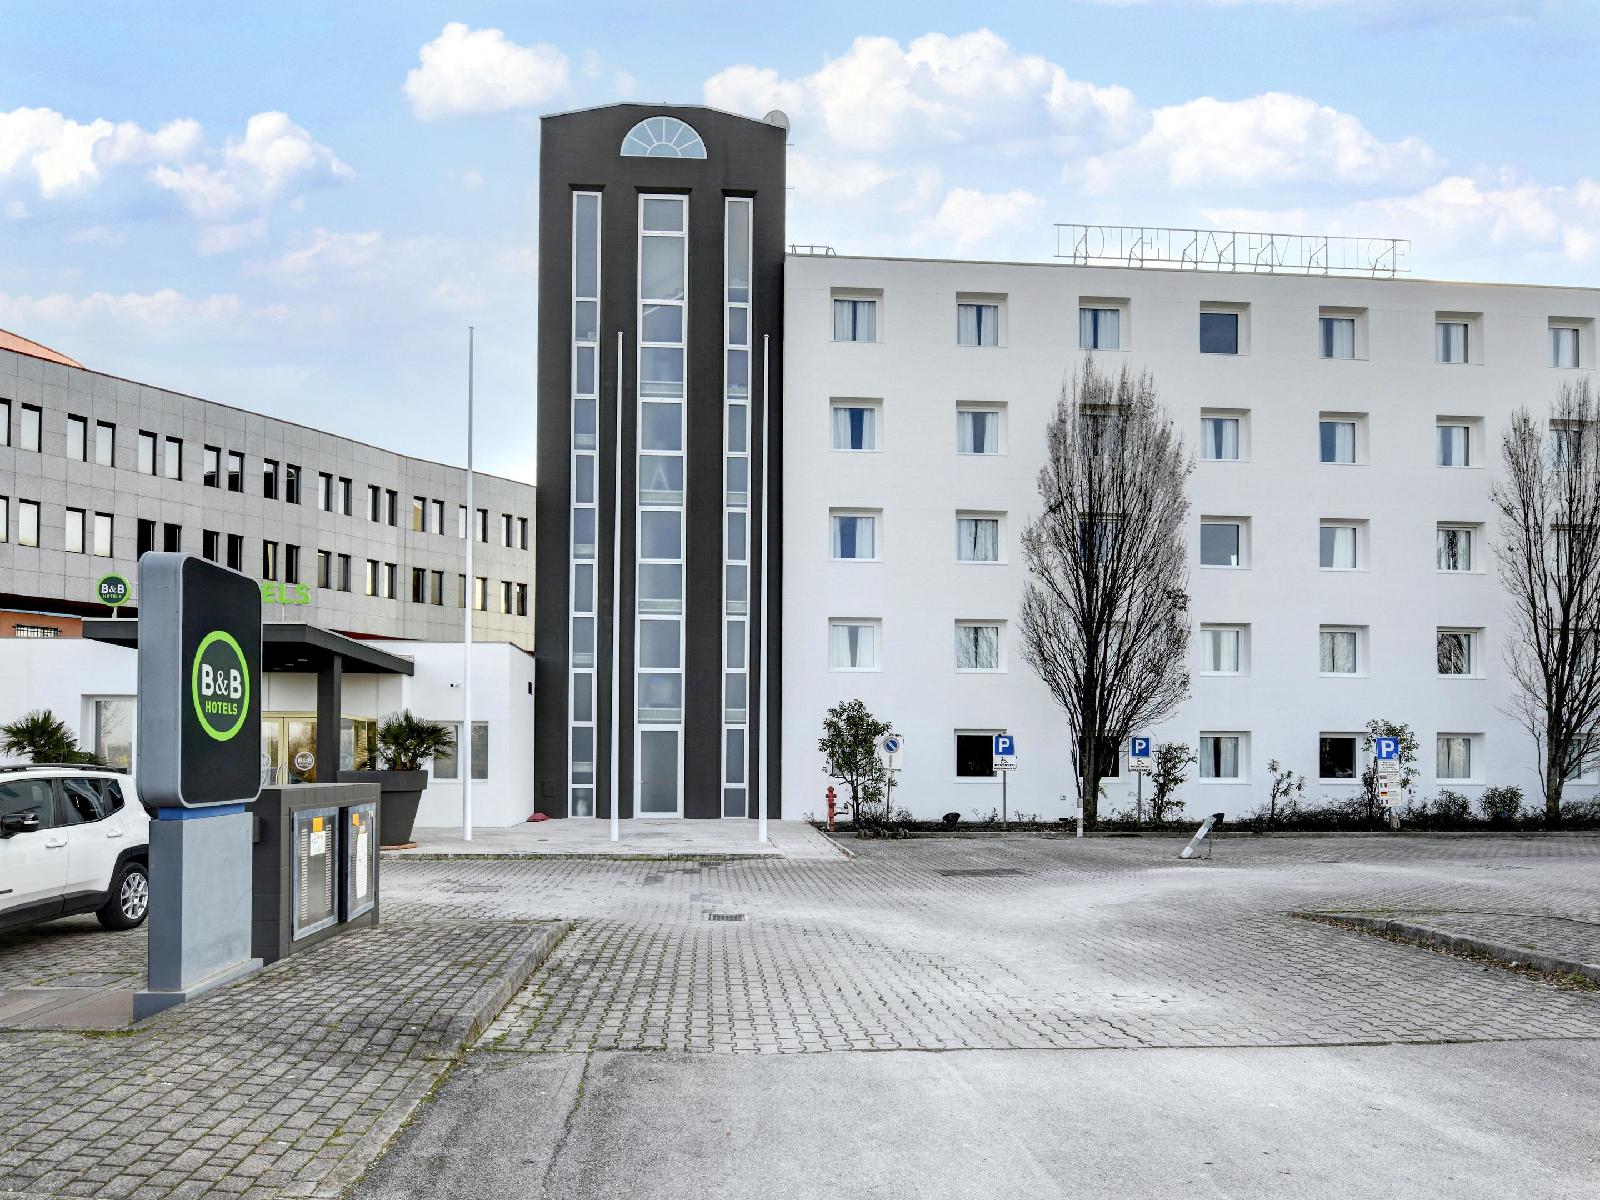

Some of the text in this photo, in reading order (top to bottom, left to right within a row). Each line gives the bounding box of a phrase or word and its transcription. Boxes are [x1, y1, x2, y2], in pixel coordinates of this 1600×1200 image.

[101, 583, 125, 594] B&B
[262, 583, 312, 605] ELS
[201, 663, 242, 699] B&B
[205, 700, 238, 715] HOTELS
[998, 738, 1010, 752] P
[1135, 739, 1147, 753] P
[1381, 740, 1395, 757] P
